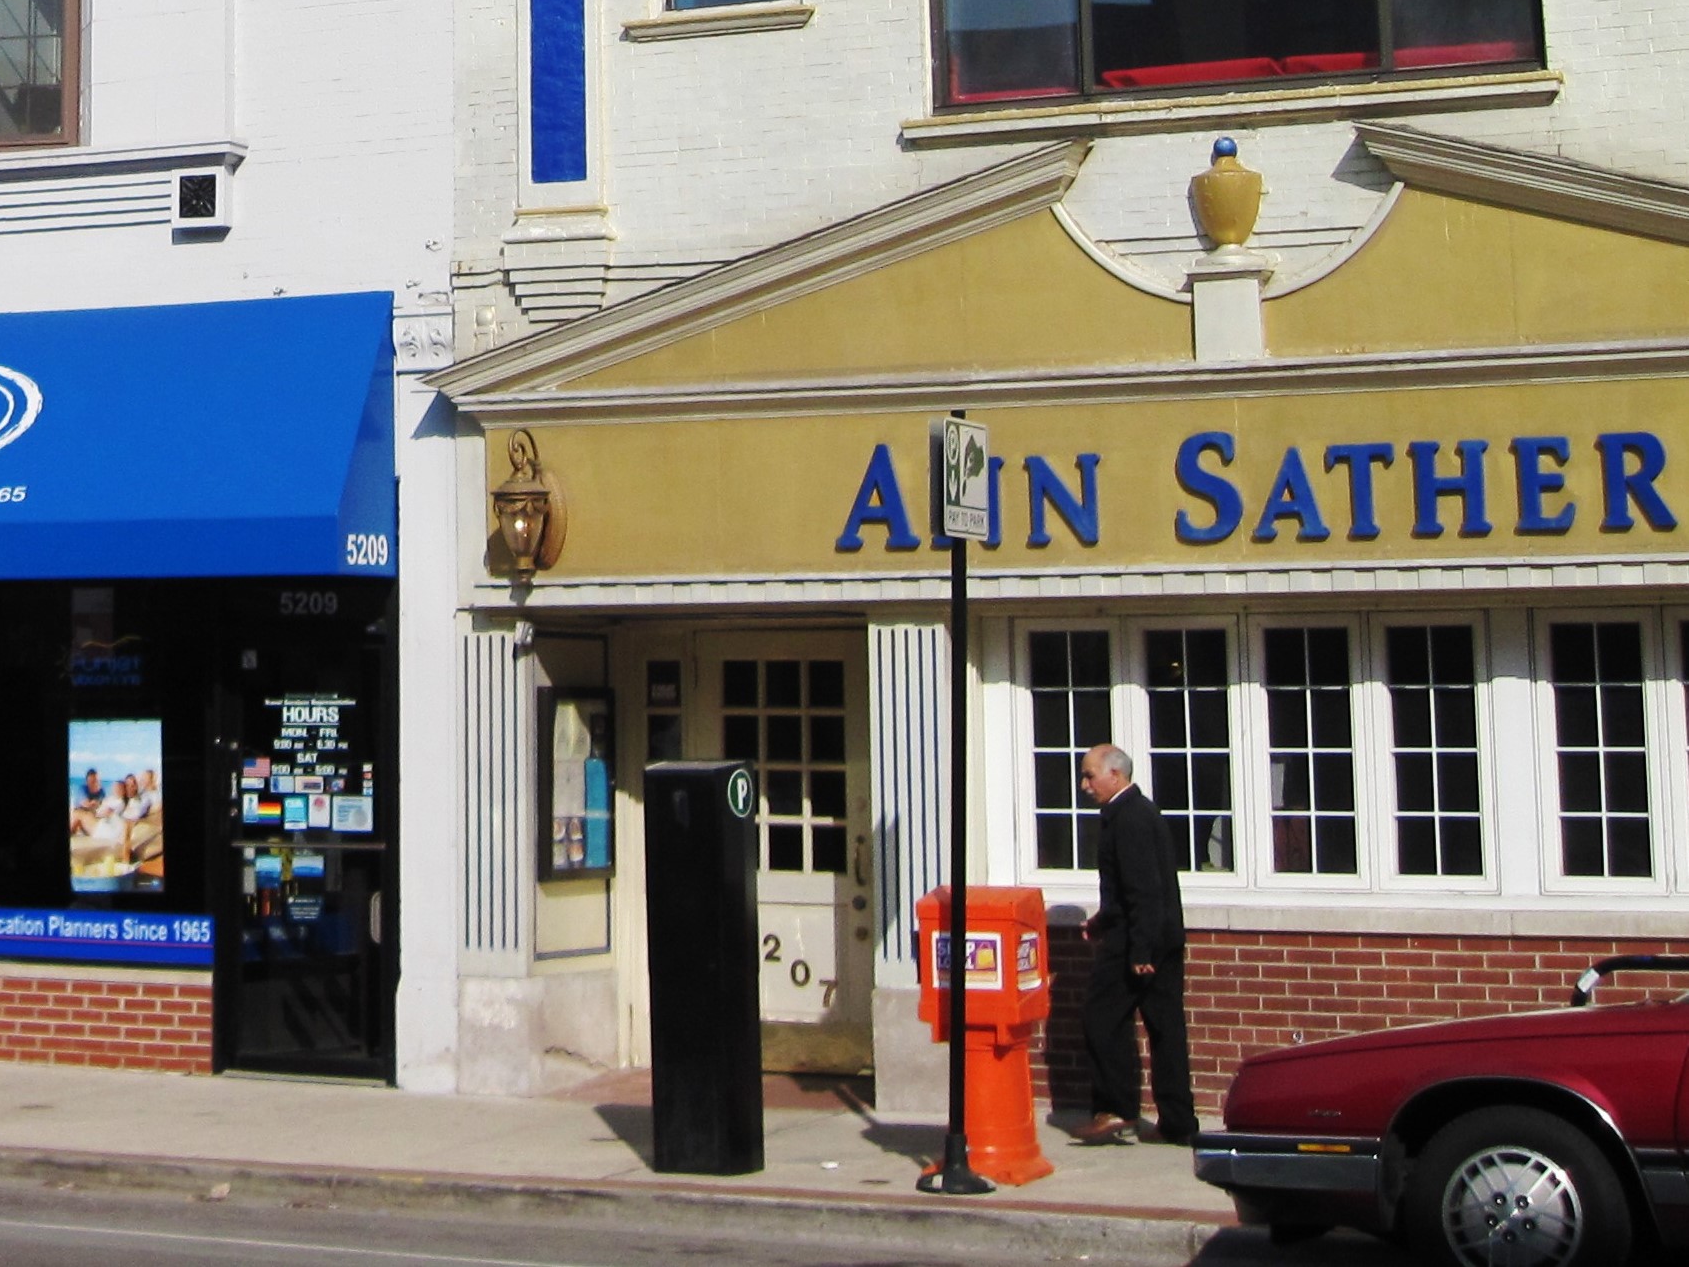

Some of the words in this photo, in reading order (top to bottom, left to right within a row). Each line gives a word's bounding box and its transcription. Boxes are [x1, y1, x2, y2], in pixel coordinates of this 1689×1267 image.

[1174, 430, 1678, 544] SATHER
[347, 534, 388, 565] 5209
[280, 591, 338, 614] 5209
[282, 706, 339, 723] HOURS
[296, 753, 318, 764] SAT
[49, 915, 118, 940] Planners
[122, 918, 168, 941] Since
[173, 920, 211, 943] 1965
